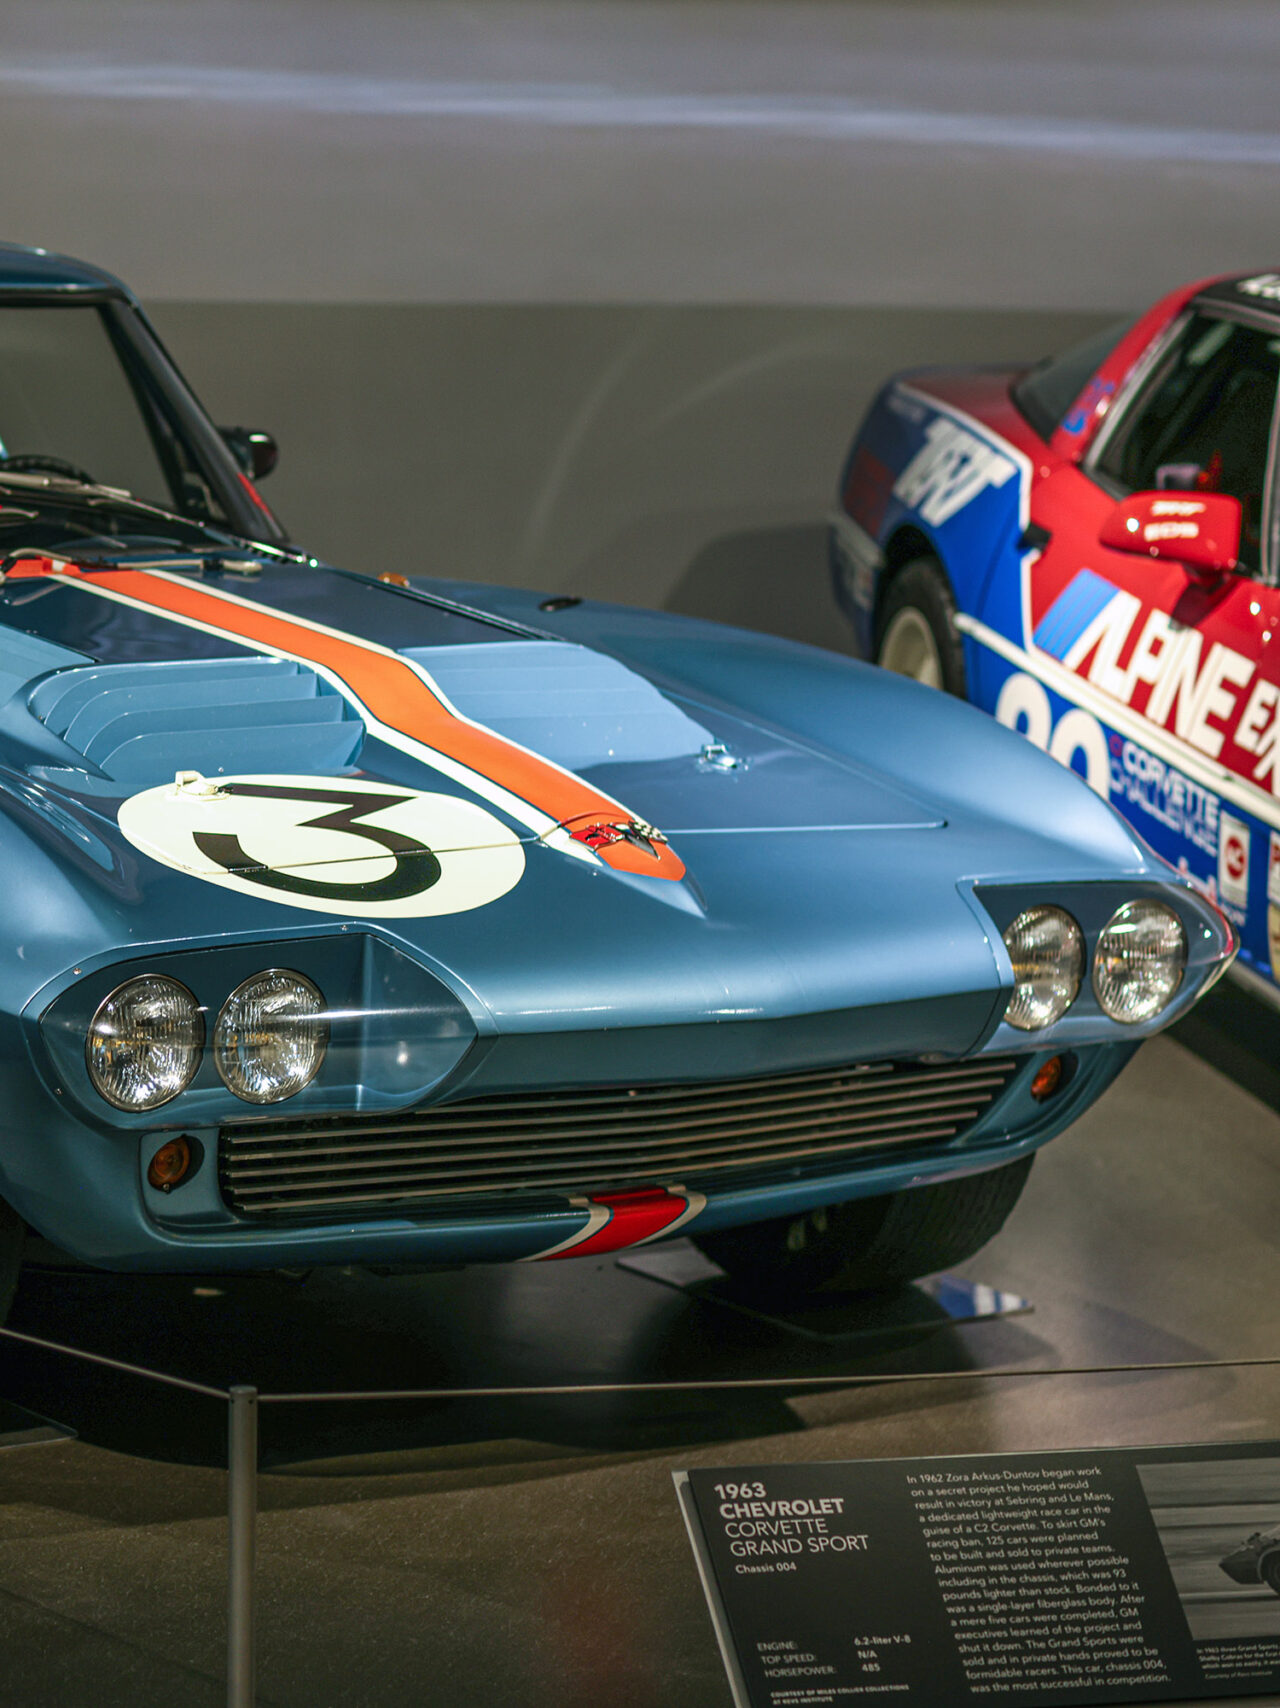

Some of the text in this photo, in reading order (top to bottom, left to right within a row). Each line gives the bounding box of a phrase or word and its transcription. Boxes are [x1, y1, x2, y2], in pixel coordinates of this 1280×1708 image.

[1062, 589, 1256, 758] ALPINE
[193, 783, 441, 901] 3
[906, 1475, 917, 1484] In
[920, 1474, 943, 1483] 1962
[946, 1473, 969, 1482] Zora
[1042, 1468, 1075, 1480] began
[1077, 1467, 1101, 1476] work
[714, 1482, 767, 1500] 1963
[936, 1486, 966, 1496] secret
[968, 1484, 1006, 1496] project
[1006, 1483, 1020, 1492] he
[1022, 1482, 1057, 1494] hoped
[1058, 1480, 1089, 1490] would
[720, 1498, 844, 1519] CHEVROLET
[914, 1500, 943, 1509] result
[945, 1499, 955, 1508] in
[957, 1498, 992, 1510] victory
[993, 1497, 1004, 1506] at
[1006, 1495, 1046, 1507] Sebring
[1048, 1494, 1068, 1503] and
[1069, 1493, 1082, 1502] Le
[927, 1511, 979, 1522] dedicated
[981, 1508, 1038, 1521] lightweight
[1082, 1505, 1092, 1514] in
[1093, 1504, 1110, 1514] the
[725, 1518, 829, 1538] CORVETTE
[922, 1525, 951, 1537] guise
[952, 1525, 964, 1534] of
[973, 1524, 989, 1532] C2
[1040, 1520, 1054, 1529] To
[1056, 1519, 1078, 1529] skirt
[730, 1535, 869, 1557] GRAND SPORT
[926, 1538, 959, 1550] racing
[986, 1536, 1004, 1544] 125
[1057, 1531, 1099, 1543] planned
[929, 1552, 942, 1561] to
[943, 1551, 958, 1560] be
[960, 1550, 983, 1559] built
[985, 1549, 1005, 1558] and
[1007, 1548, 1029, 1557] sold
[1030, 1547, 1042, 1556] to
[1044, 1546, 1080, 1558] private
[735, 1562, 797, 1574] Chassis 004
[934, 1563, 986, 1574] Aluminum
[1010, 1560, 1036, 1570] used
[1038, 1558, 1084, 1568] wherever
[1086, 1556, 1130, 1568] possible
[938, 1576, 986, 1589] including
[987, 1576, 998, 1584] in
[1000, 1574, 1016, 1584] the
[1060, 1571, 1089, 1580] which
[1112, 1569, 1126, 1578] 93
[942, 1590, 982, 1602] pounds
[984, 1588, 1017, 1600] lighter
[1018, 1587, 1042, 1596] than
[1076, 1583, 1117, 1593] Bonded
[1118, 1582, 1130, 1591] to
[1131, 1582, 1139, 1590] it
[1037, 1597, 1087, 1610] fiberglass
[1120, 1594, 1145, 1604] After
[988, 1615, 1007, 1624] five
[1119, 1608, 1139, 1617] GM
[954, 1621, 1142, 1639] executives learned of the project and
[854, 1636, 892, 1646] 6.2-liter
[893, 1634, 911, 1644] V-8
[958, 1643, 980, 1652] shut
[982, 1643, 990, 1651] it
[1026, 1640, 1046, 1649] The
[1048, 1638, 1081, 1648] Grand
[1082, 1636, 1118, 1648] Sports
[1119, 1636, 1144, 1644] were
[761, 1655, 781, 1665] TOP
[857, 1650, 878, 1659] N/A
[962, 1647, 1158, 1666] sold and in private hands proved to be
[862, 1663, 881, 1672] 485
[966, 1667, 1023, 1679] formidable
[1061, 1664, 1083, 1674] This
[1105, 1661, 1141, 1671] chassis
[992, 1682, 1010, 1691] the
[1012, 1680, 1038, 1690] most
[1040, 1677, 1092, 1688] successful
[1094, 1676, 1105, 1685] in
